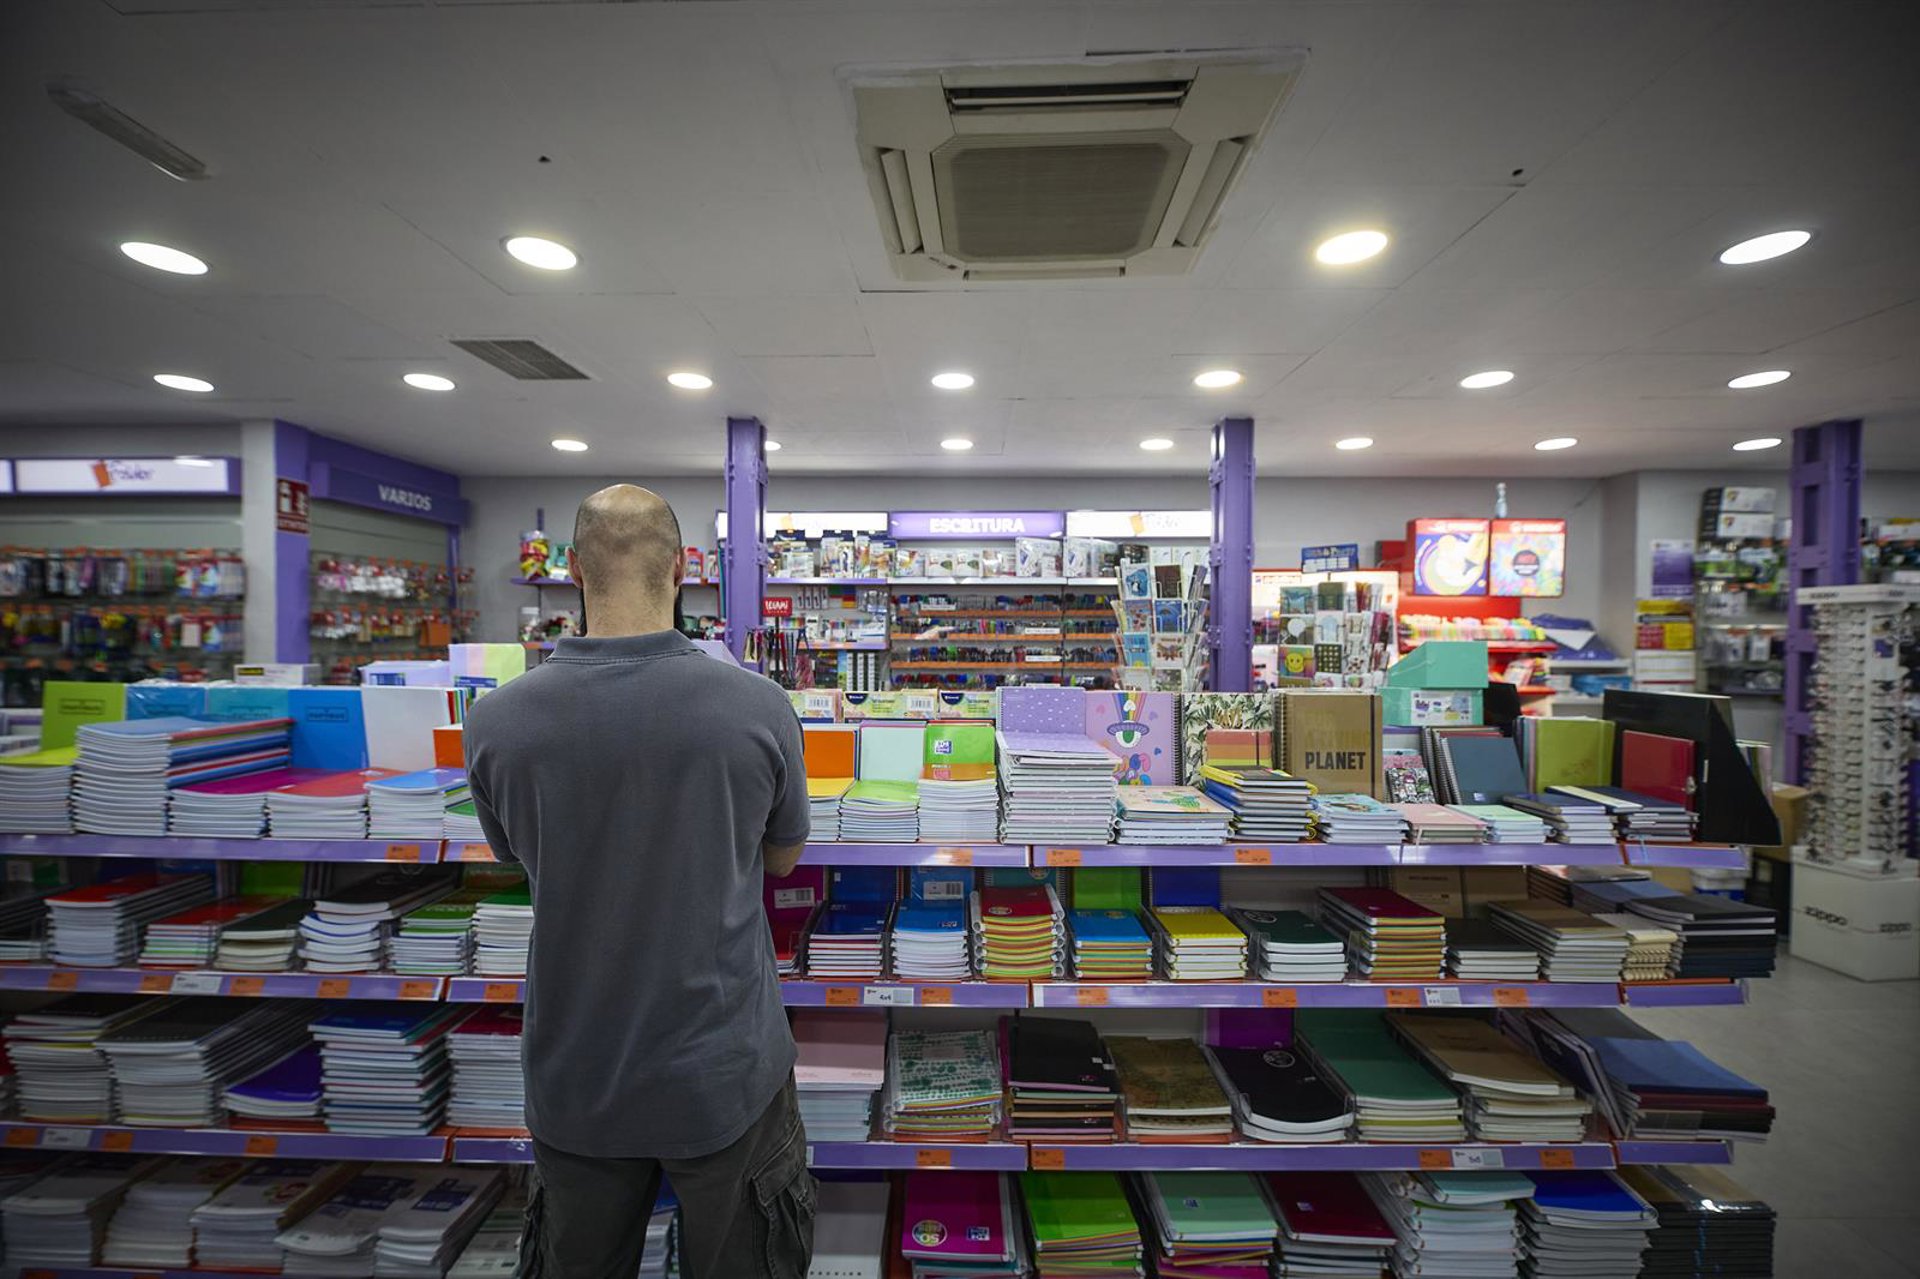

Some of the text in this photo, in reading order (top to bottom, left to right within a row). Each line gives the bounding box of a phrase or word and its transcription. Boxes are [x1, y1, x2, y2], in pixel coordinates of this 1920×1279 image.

[378, 484, 432, 511] VARIOS
[929, 518, 1025, 533] ESCRITURA
[1305, 752, 1366, 770] PLANET
